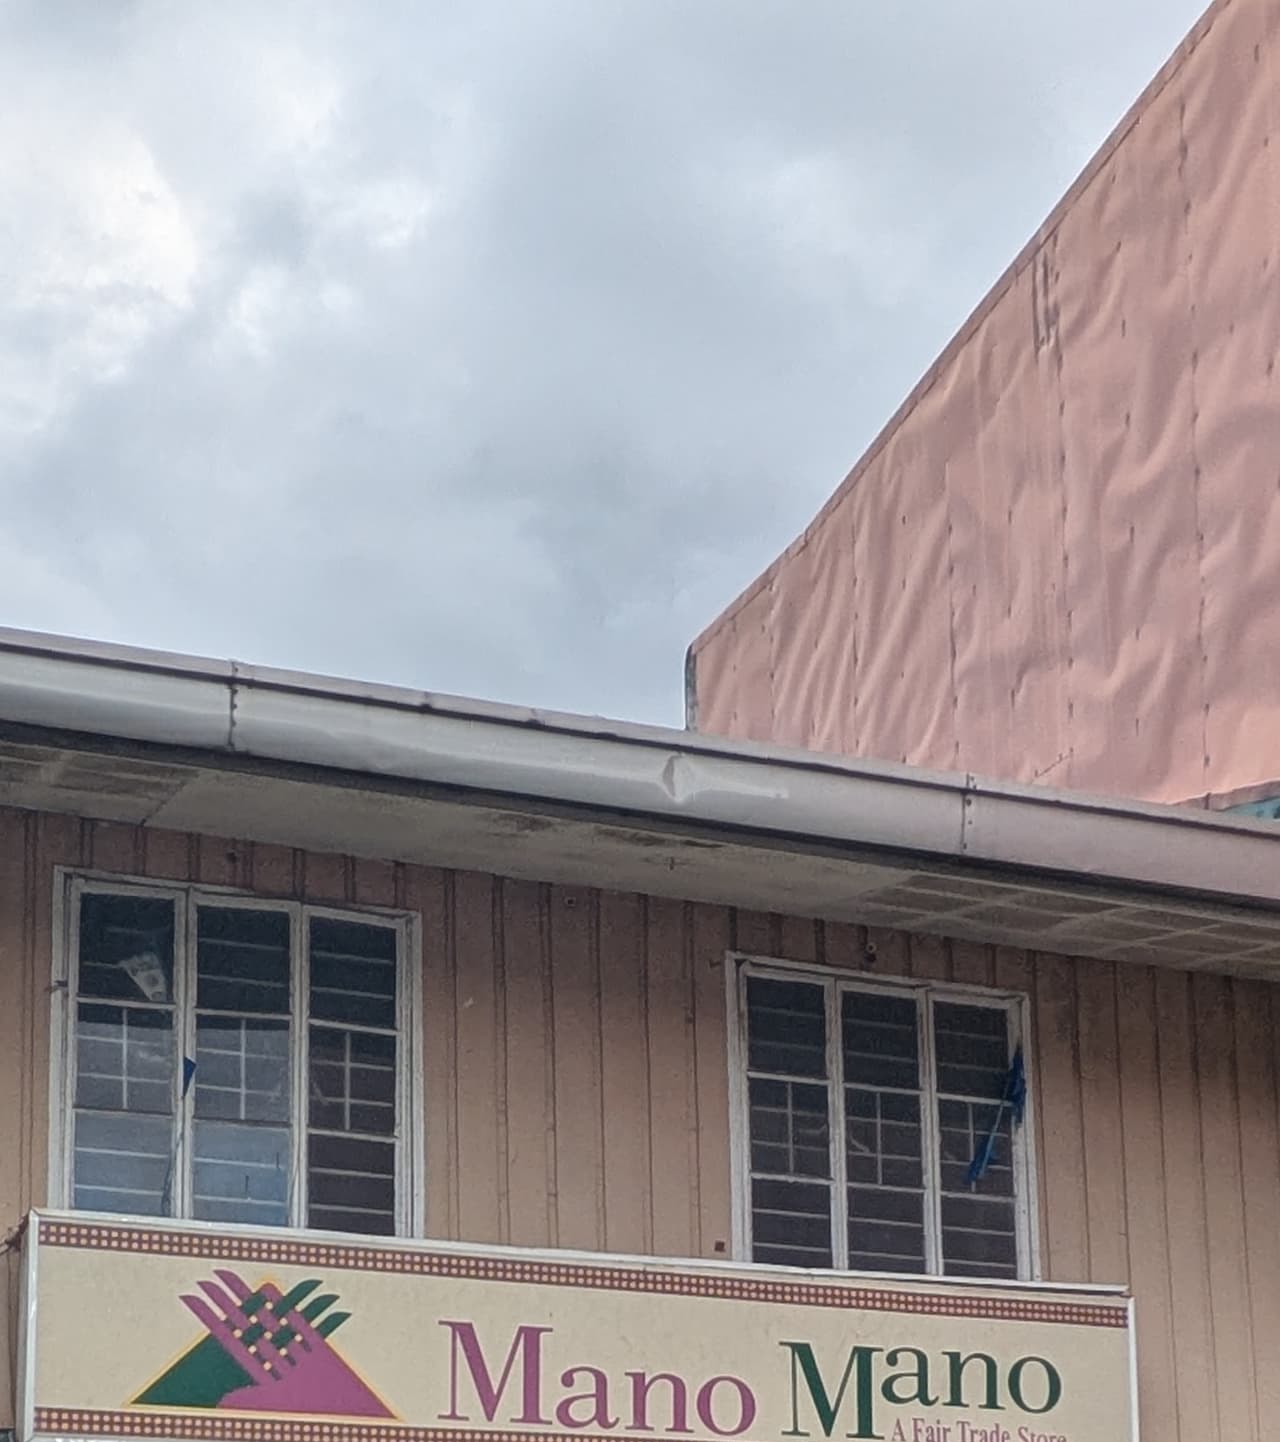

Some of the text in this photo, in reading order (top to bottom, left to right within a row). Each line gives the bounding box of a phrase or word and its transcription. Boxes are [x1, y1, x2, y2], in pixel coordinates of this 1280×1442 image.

[438, 1320, 1062, 1440] Mano Mano
[891, 1417, 907, 1442] A
